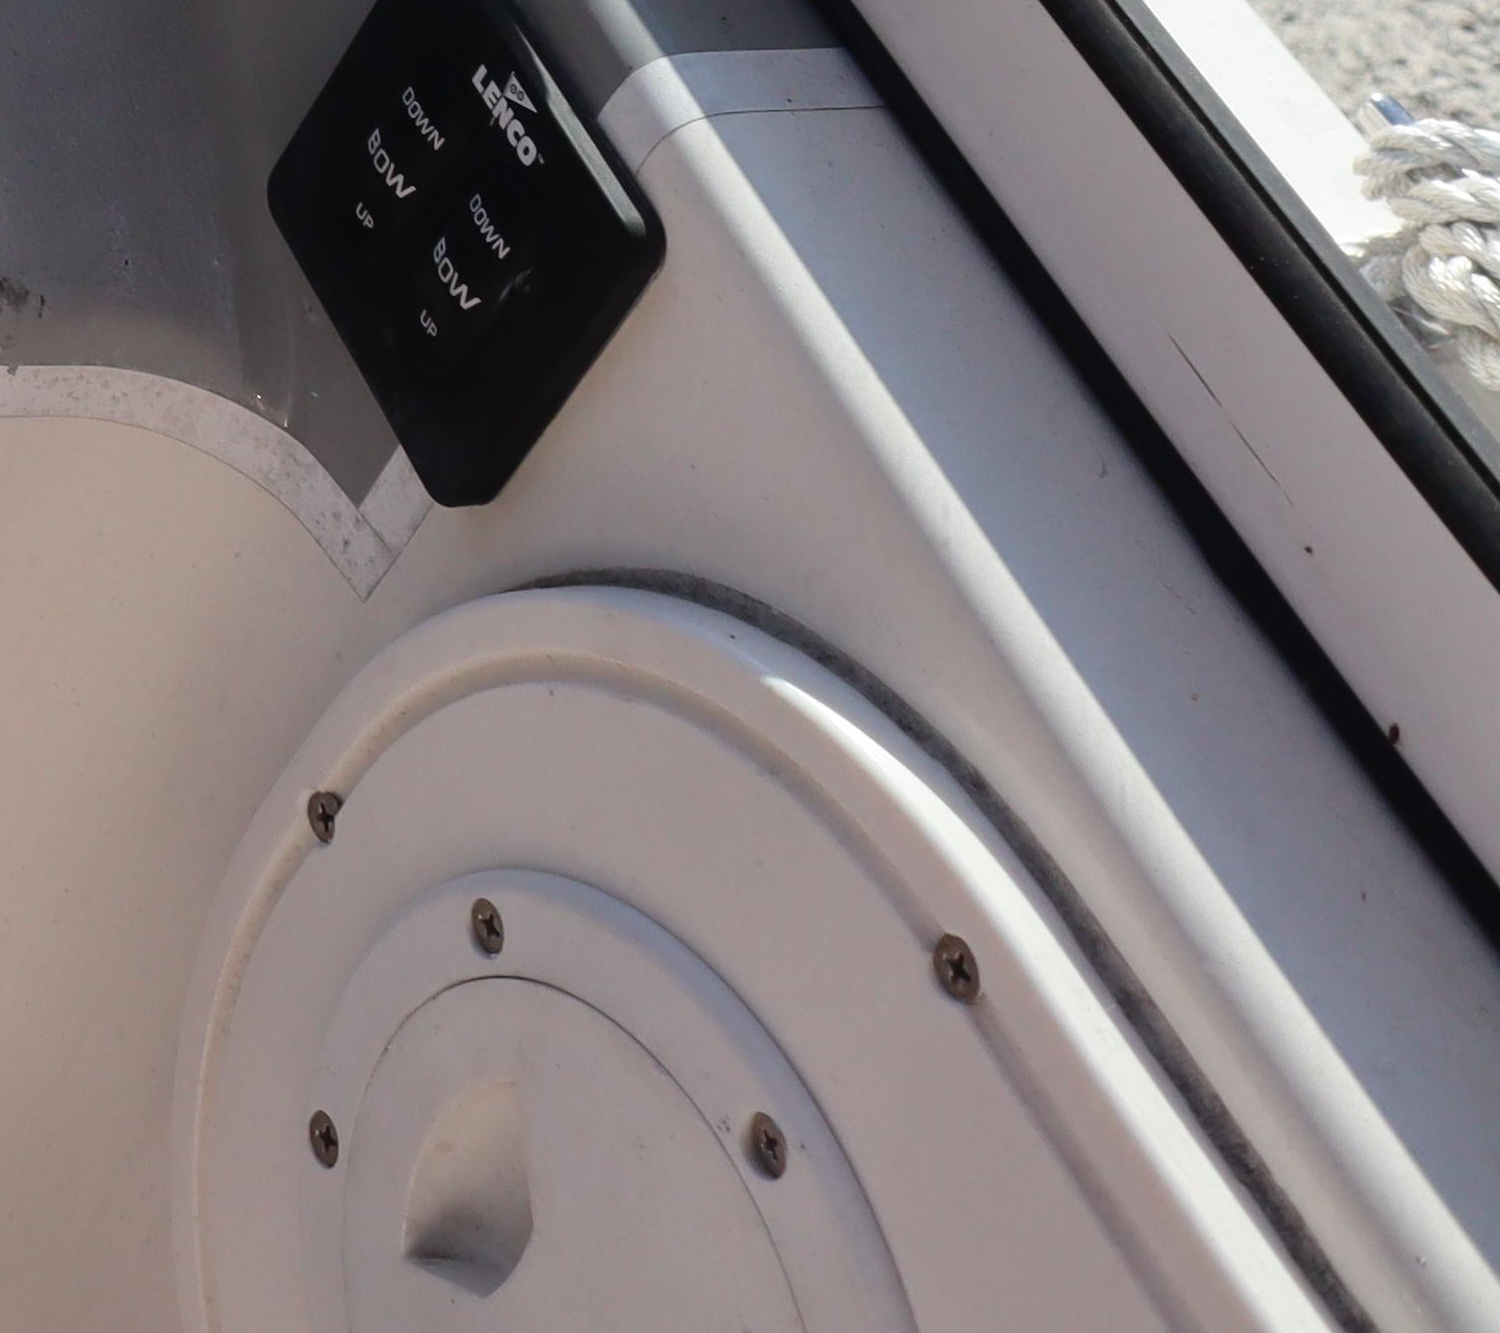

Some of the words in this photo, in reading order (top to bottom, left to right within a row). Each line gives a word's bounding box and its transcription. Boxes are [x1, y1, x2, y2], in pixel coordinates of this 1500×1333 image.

[402, 85, 446, 152] DOWN
[472, 64, 537, 166] LENCO
[367, 128, 417, 199] BOW
[355, 201, 375, 230] UP
[468, 193, 511, 260] DOWN
[433, 236, 482, 311] BOW
[419, 308, 439, 339] UP
